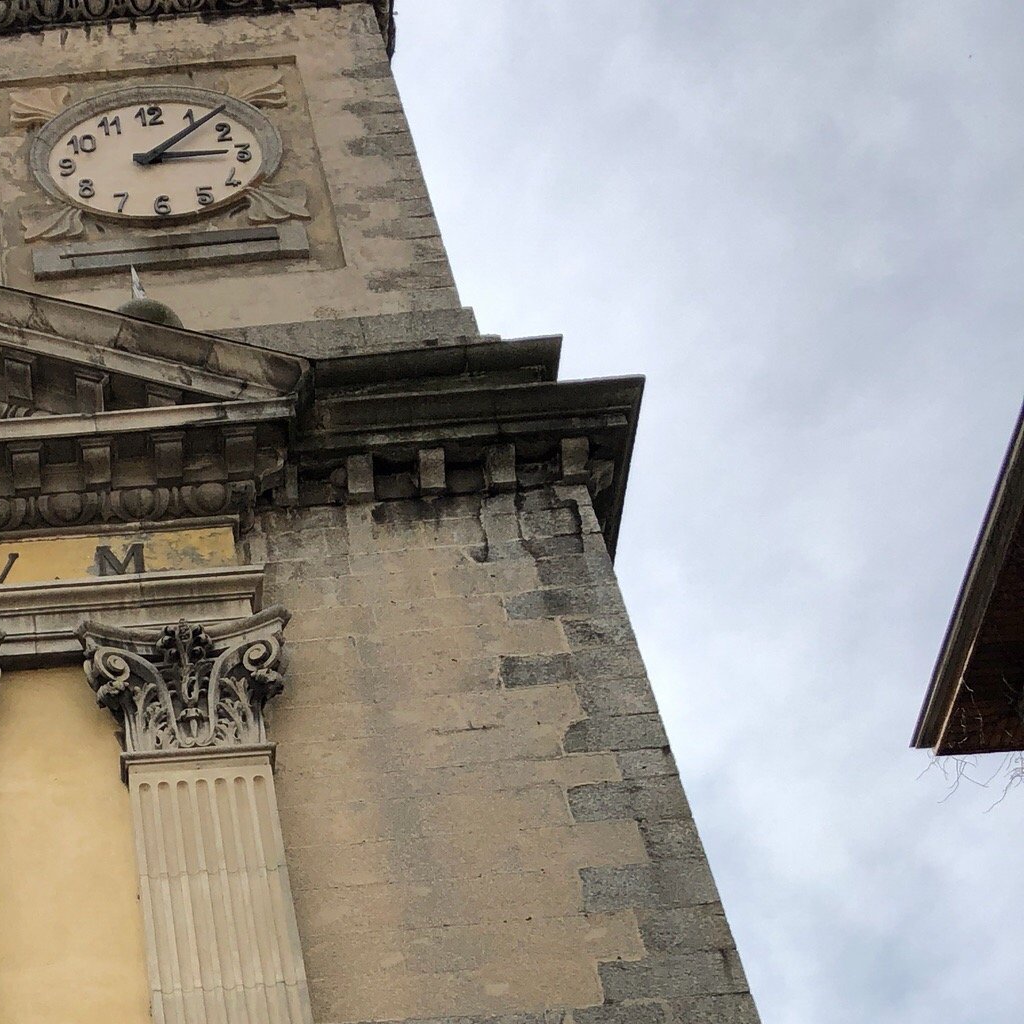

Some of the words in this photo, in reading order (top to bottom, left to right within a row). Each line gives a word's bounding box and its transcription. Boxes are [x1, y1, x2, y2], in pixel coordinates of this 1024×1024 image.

[97, 116, 122, 136] 11
[135, 106, 164, 127] 12
[215, 122, 233, 142] 2
[67, 134, 97, 154] 10
[234, 143, 252, 163] 3
[59, 158, 76, 177] 9
[225, 167, 242, 187] 4
[78, 178, 95, 198] 8
[196, 186, 214, 206] 5
[113, 192, 129, 212] 7
[154, 195, 172, 215] 6
[95, 542, 145, 577] M
